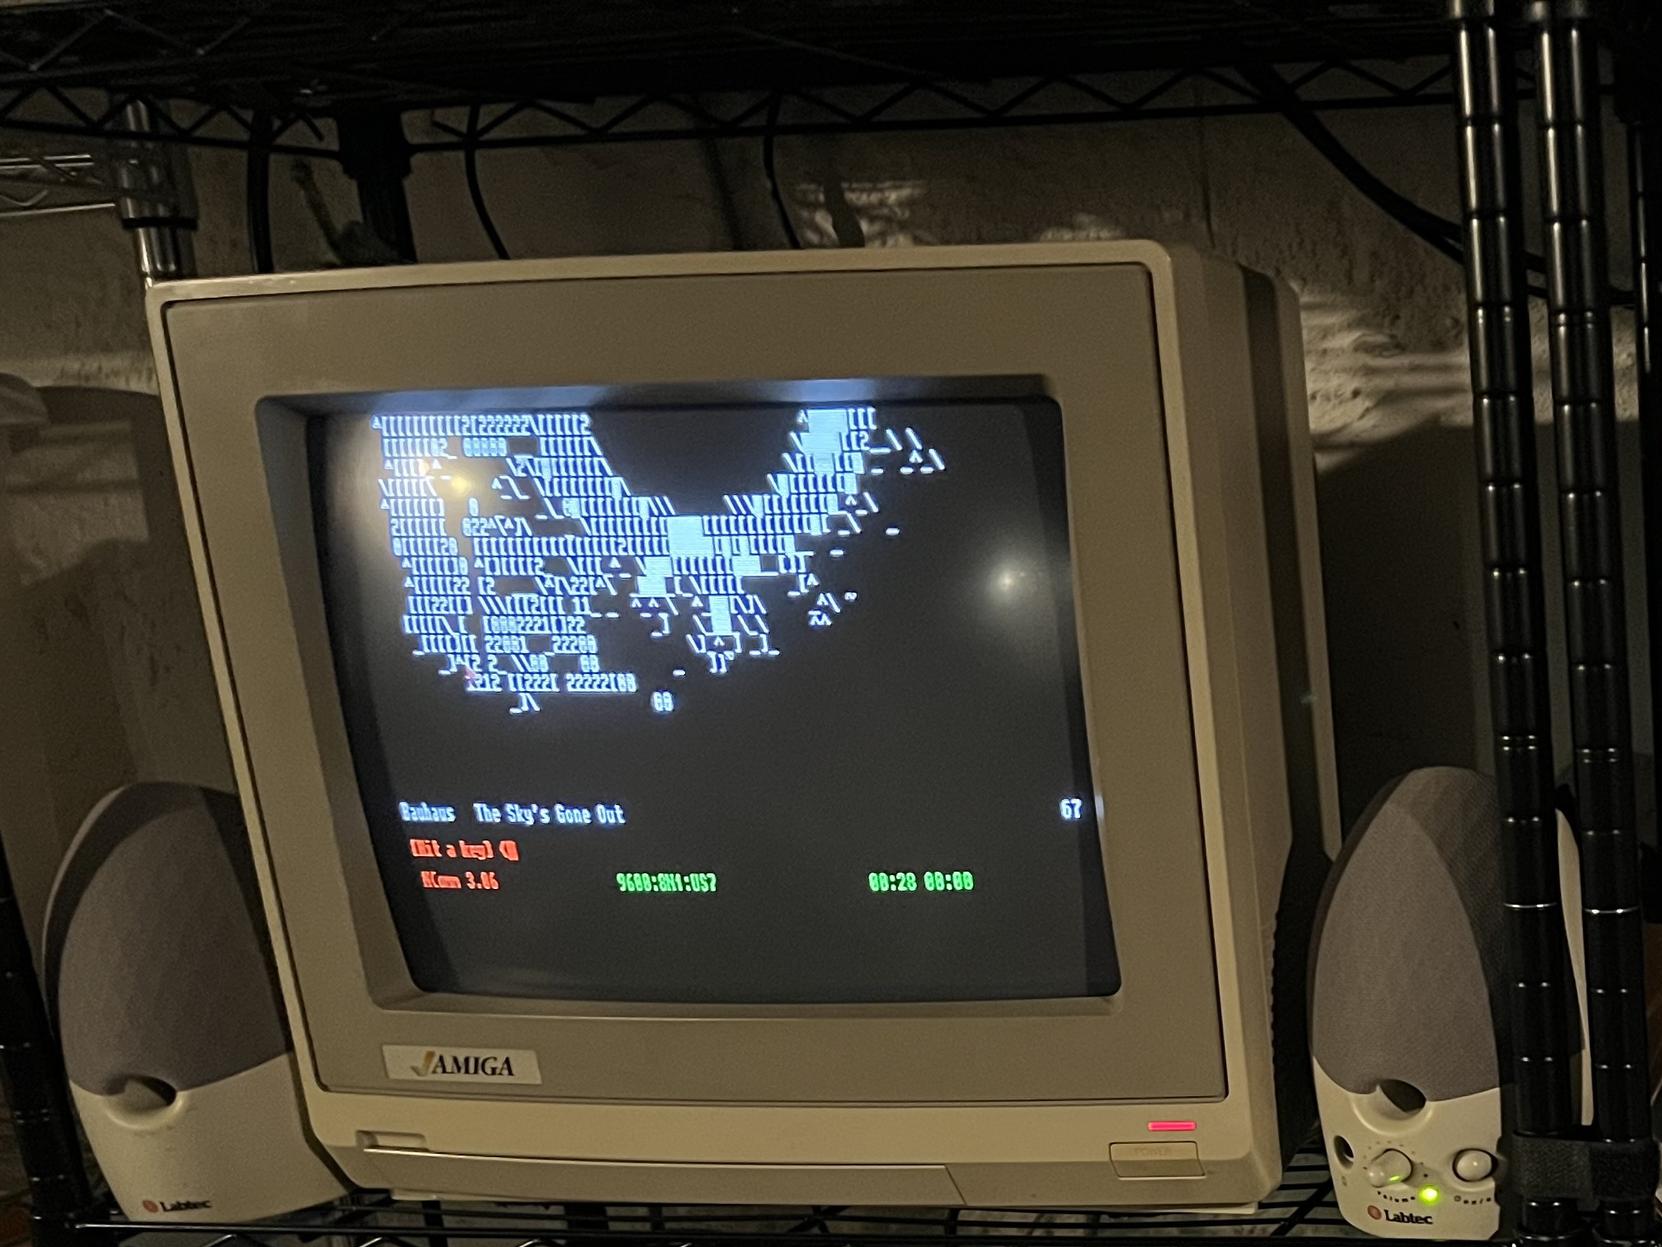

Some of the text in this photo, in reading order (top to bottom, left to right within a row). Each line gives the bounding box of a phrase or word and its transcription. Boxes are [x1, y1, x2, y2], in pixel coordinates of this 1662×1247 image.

[399, 801, 627, 827] Bauhaus The Sky's Gone Out
[1059, 798, 1082, 819] 67
[868, 869, 976, 893] 00:28 00:00
[431, 1053, 515, 1078] AMIGA
[160, 1199, 212, 1214] Labtec
[1383, 1208, 1433, 1226] Labtec
